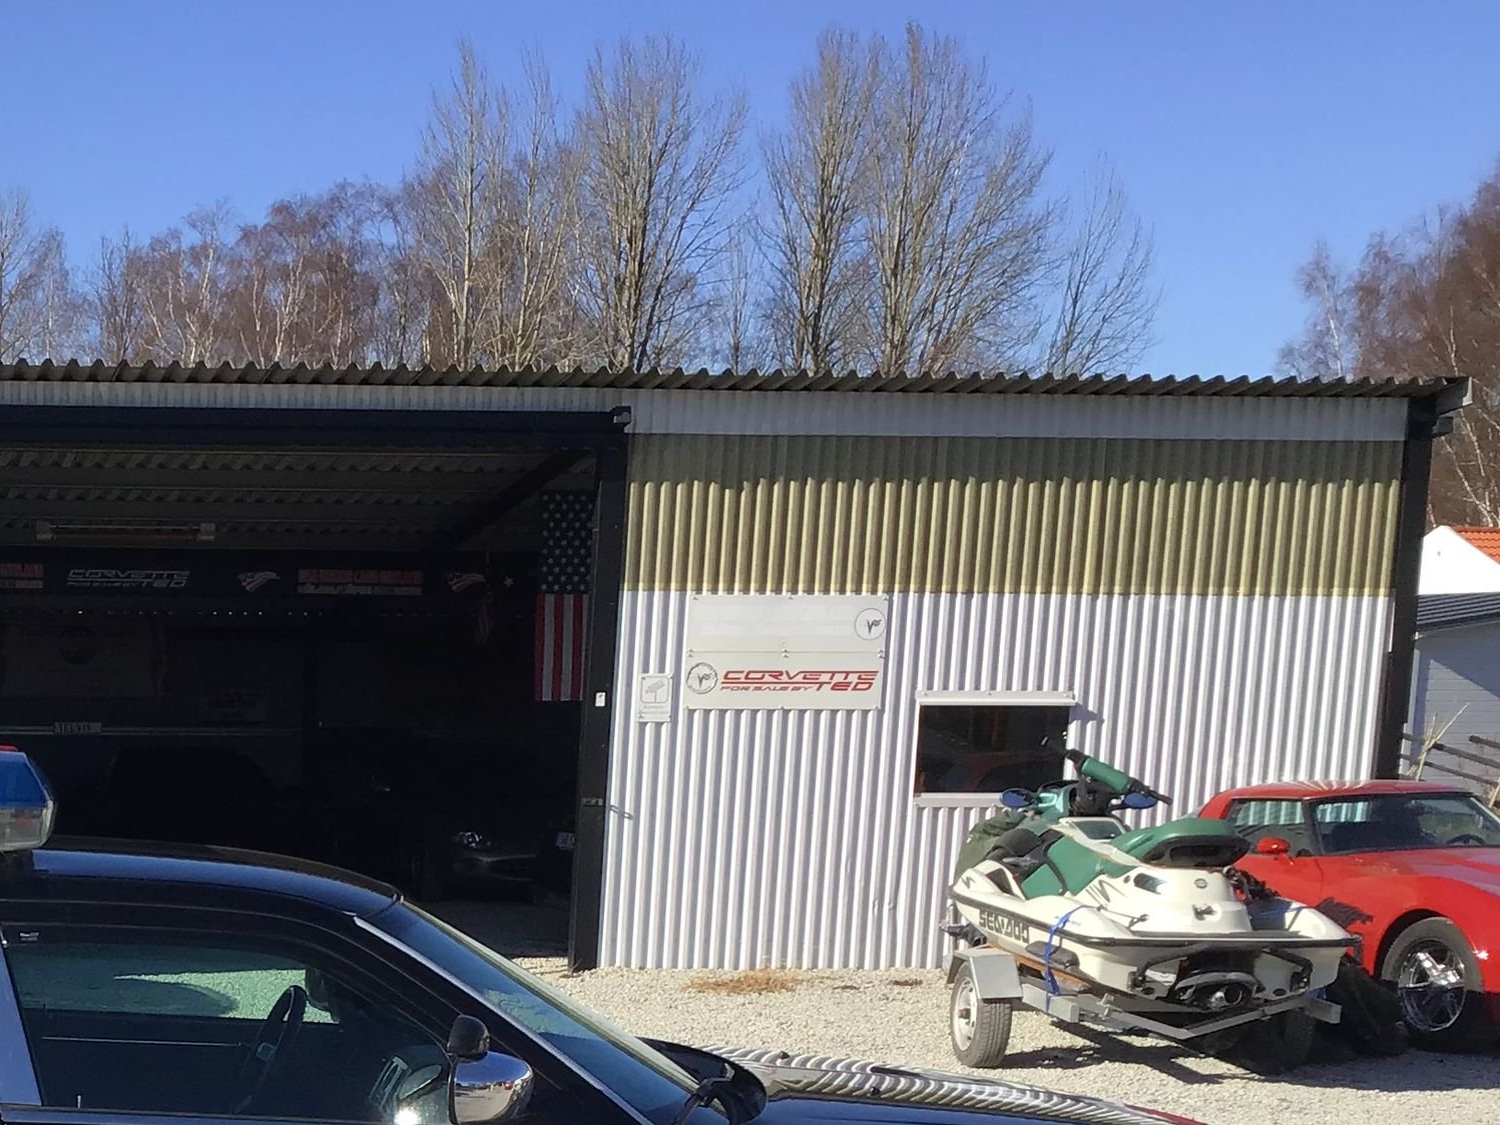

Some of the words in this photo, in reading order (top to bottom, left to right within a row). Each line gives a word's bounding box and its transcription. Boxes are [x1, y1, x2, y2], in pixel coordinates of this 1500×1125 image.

[68, 568, 191, 580] CORVETTE
[722, 669, 880, 681] CORVETTE
[815, 681, 875, 692] TED
